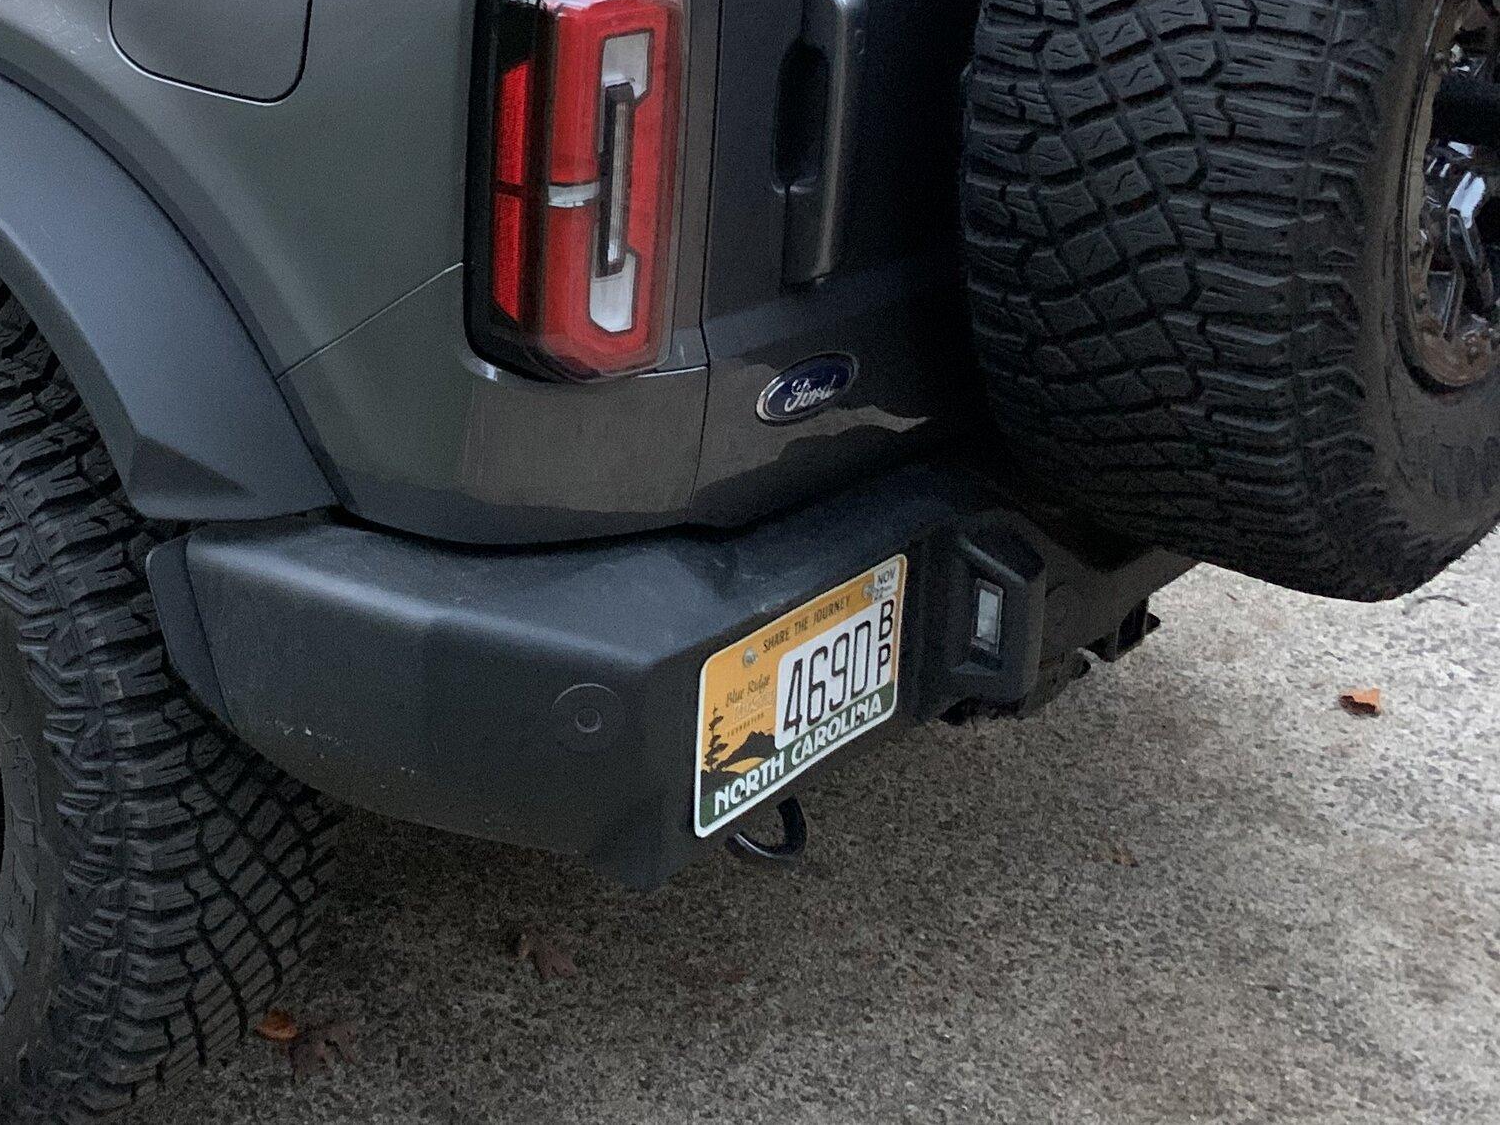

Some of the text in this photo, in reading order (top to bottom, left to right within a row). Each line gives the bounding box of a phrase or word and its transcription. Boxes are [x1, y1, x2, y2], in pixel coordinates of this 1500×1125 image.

[784, 375, 836, 412] Ford
[877, 567, 896, 585] NOV
[763, 594, 852, 653] SHARE THE JOURNEY
[726, 688, 745, 707] Blue
[747, 674, 770, 695] Ridge
[714, 751, 785, 816] NORTH
[791, 693, 882, 766] CAROLINA
